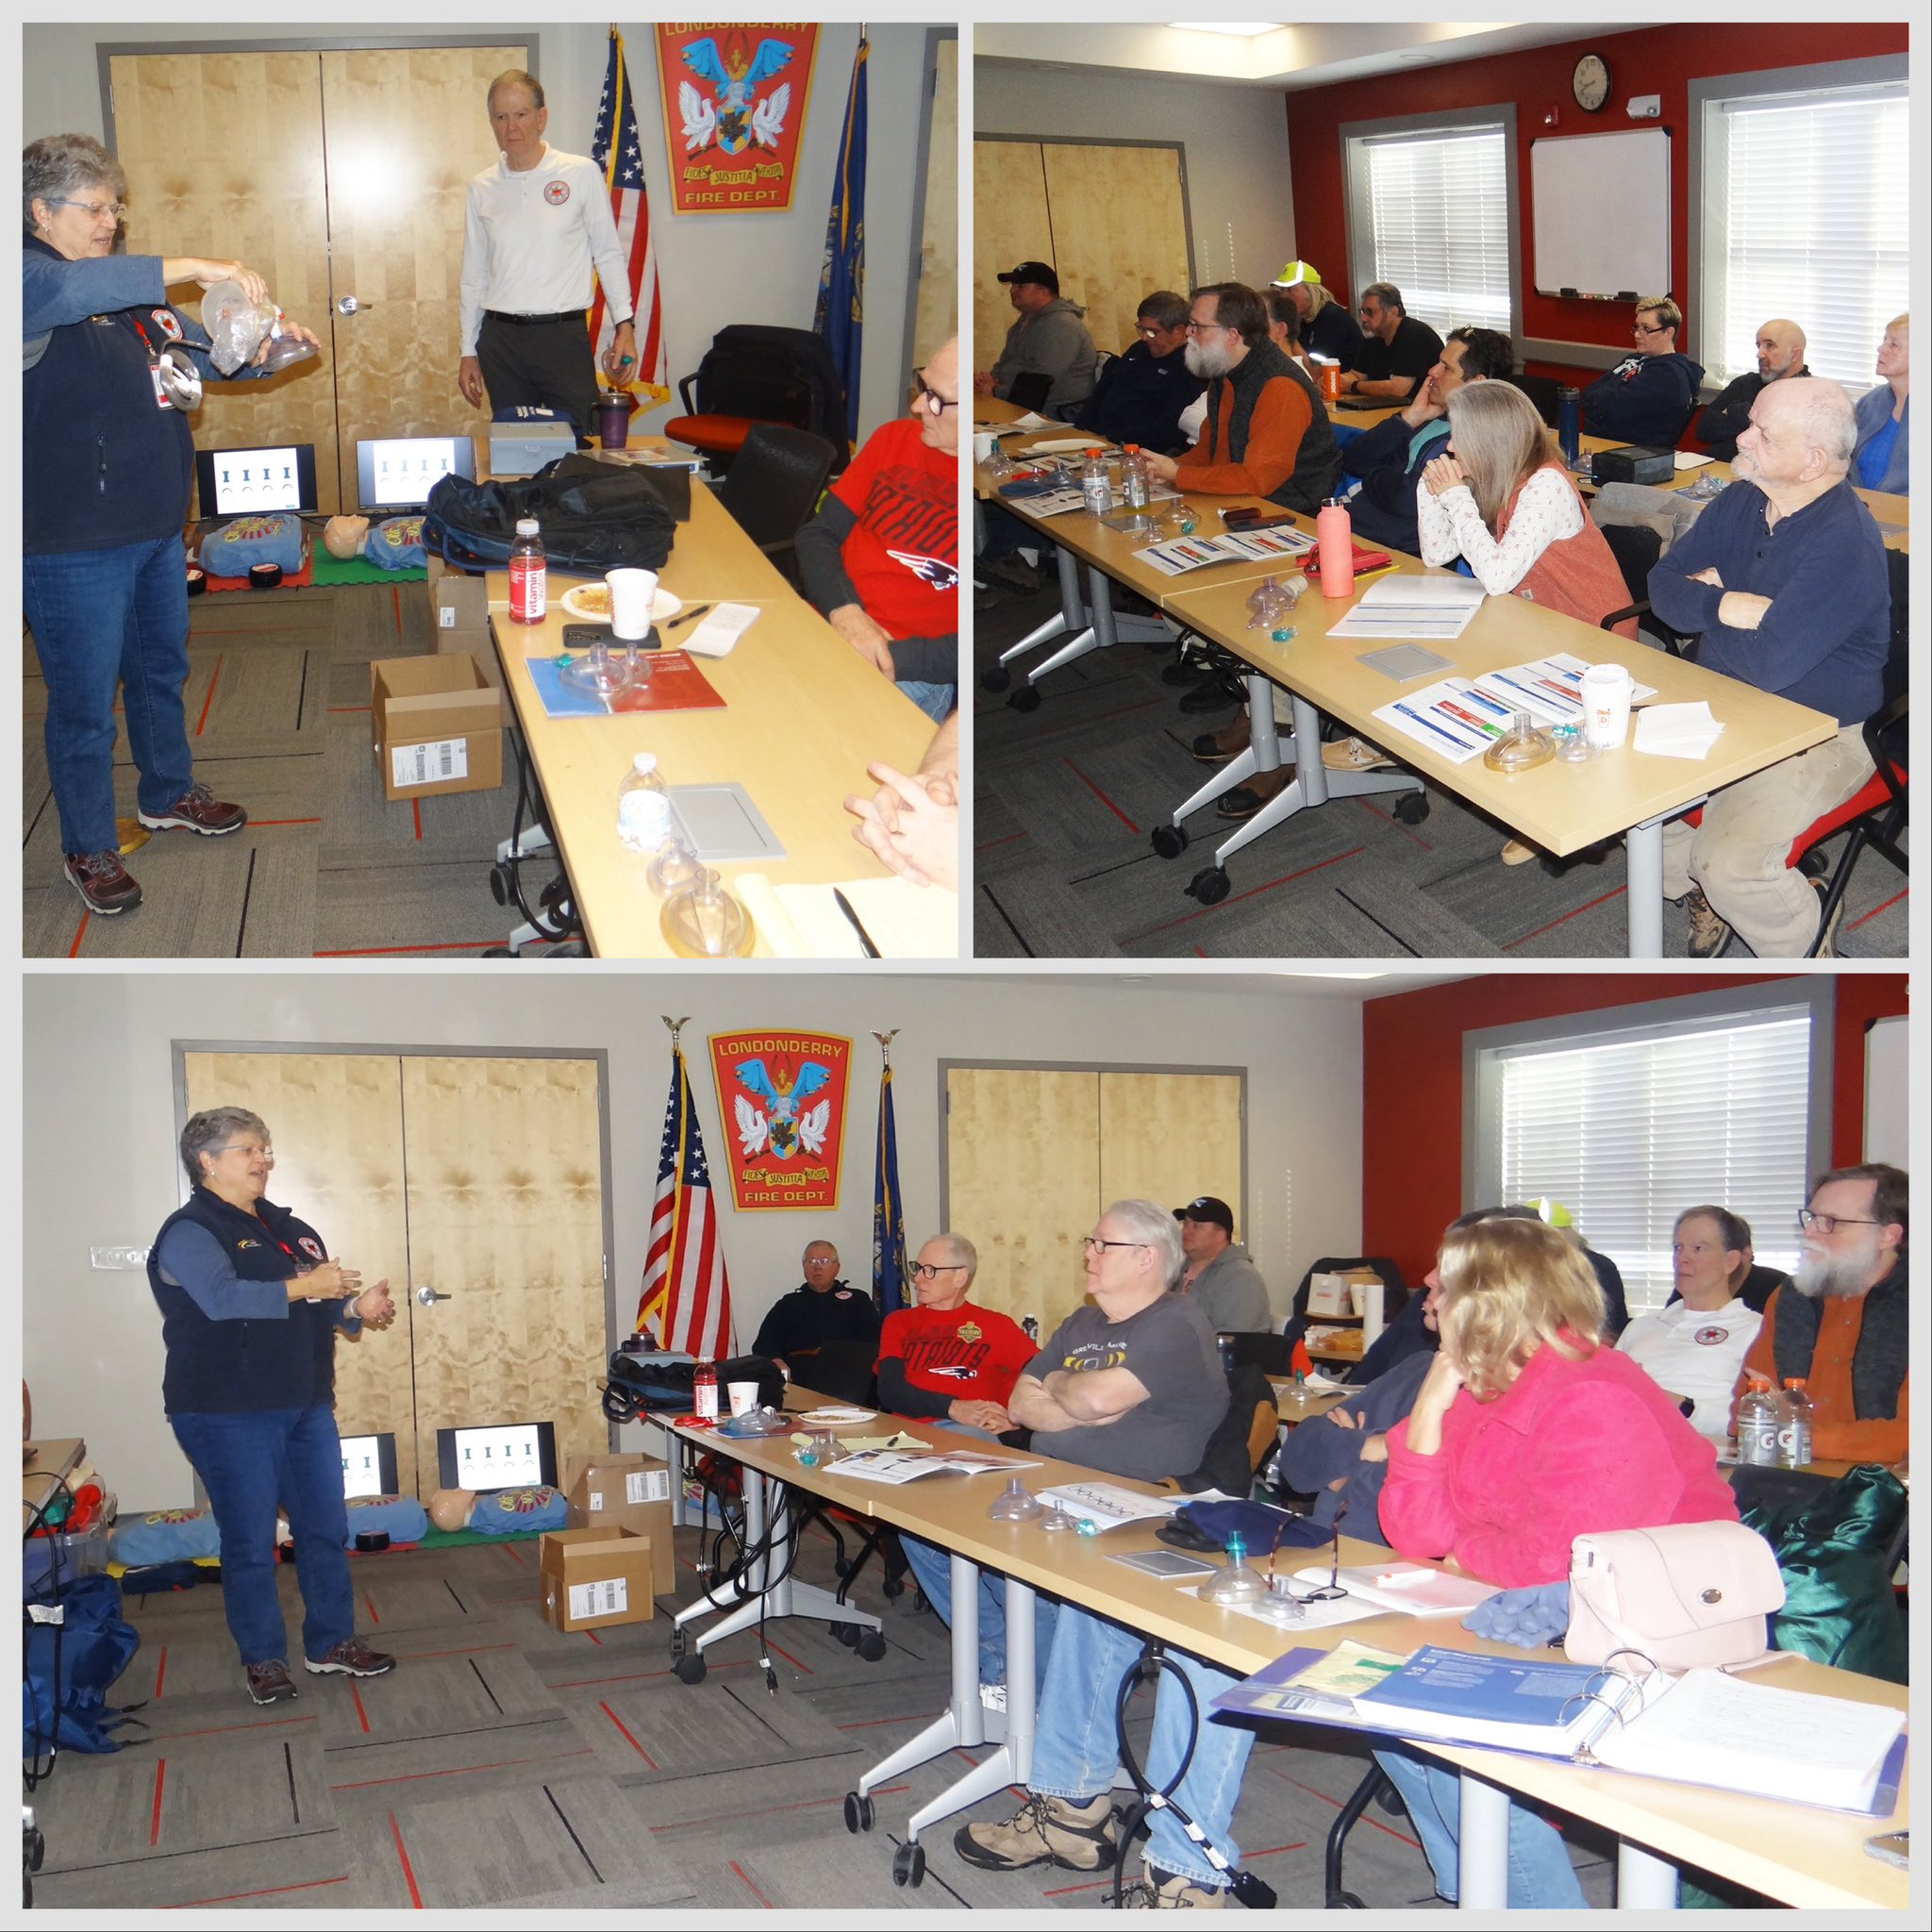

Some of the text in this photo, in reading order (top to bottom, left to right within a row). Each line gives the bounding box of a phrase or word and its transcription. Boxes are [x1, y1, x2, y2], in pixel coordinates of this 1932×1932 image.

[714, 171, 753, 183] JUSTITIA
[685, 191, 781, 204] FIRE DEPT.
[528, 572, 538, 615] vitamin
[719, 1040, 842, 1058] LONDONDERRY
[769, 1174, 804, 1184] JUSTITIA
[744, 1191, 828, 1202] FIRE DEPT.
